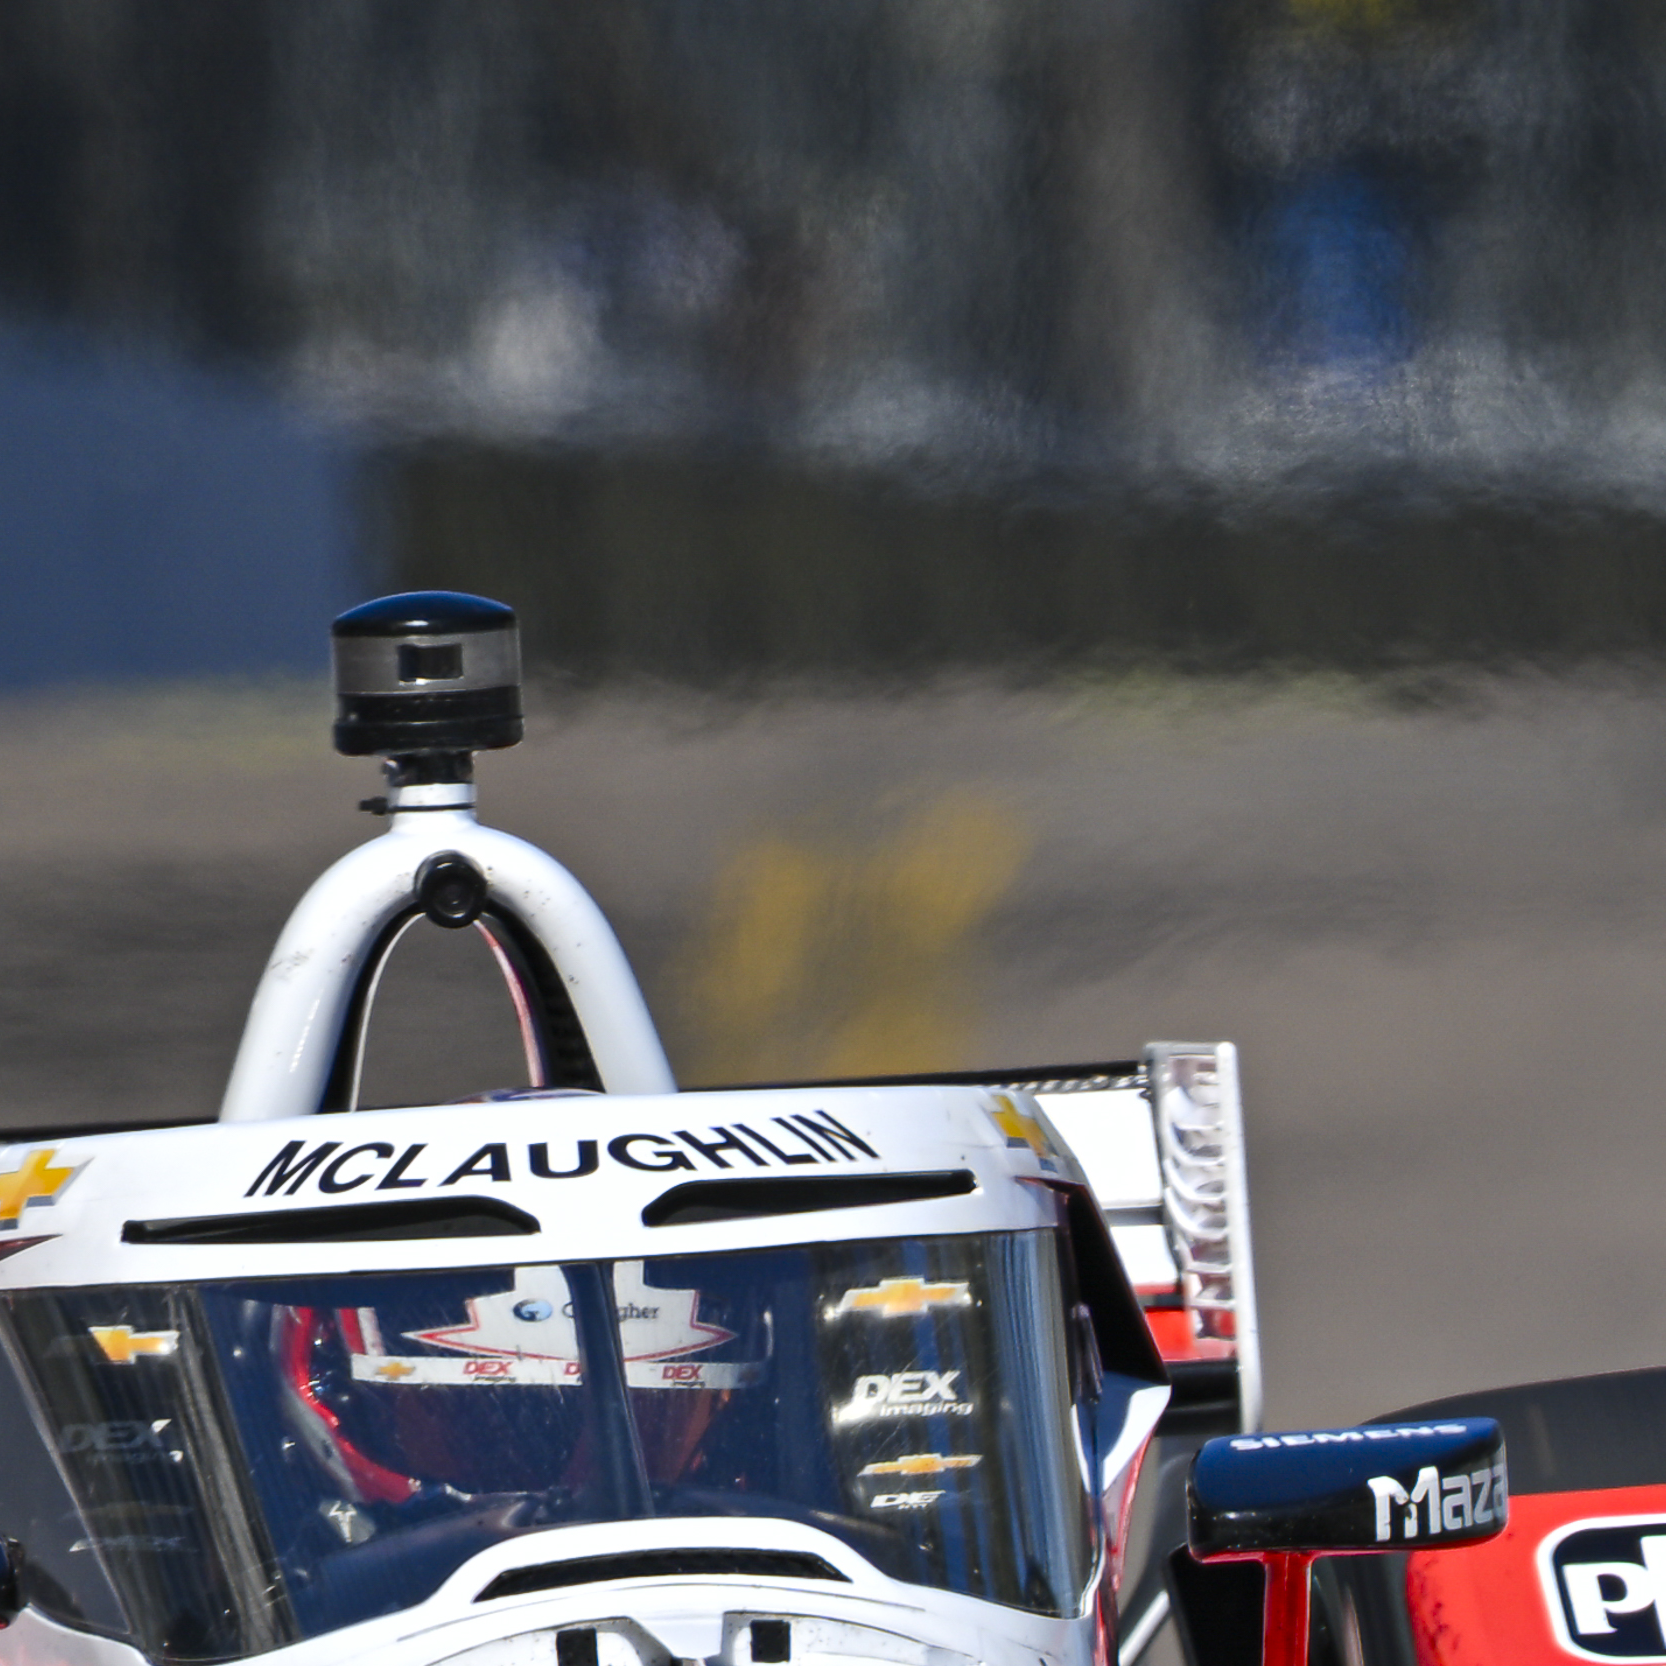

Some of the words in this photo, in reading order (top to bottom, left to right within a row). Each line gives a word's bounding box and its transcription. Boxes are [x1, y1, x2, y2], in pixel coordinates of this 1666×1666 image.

[243, 1108, 882, 1197] MCLAUGHLIN
[463, 1360, 514, 1375] DEX
[661, 1364, 704, 1380] DEX
[852, 1370, 961, 1402] DEX
[1230, 1424, 1467, 1450] SIEMENS
[1367, 1452, 1509, 1542] Maza
